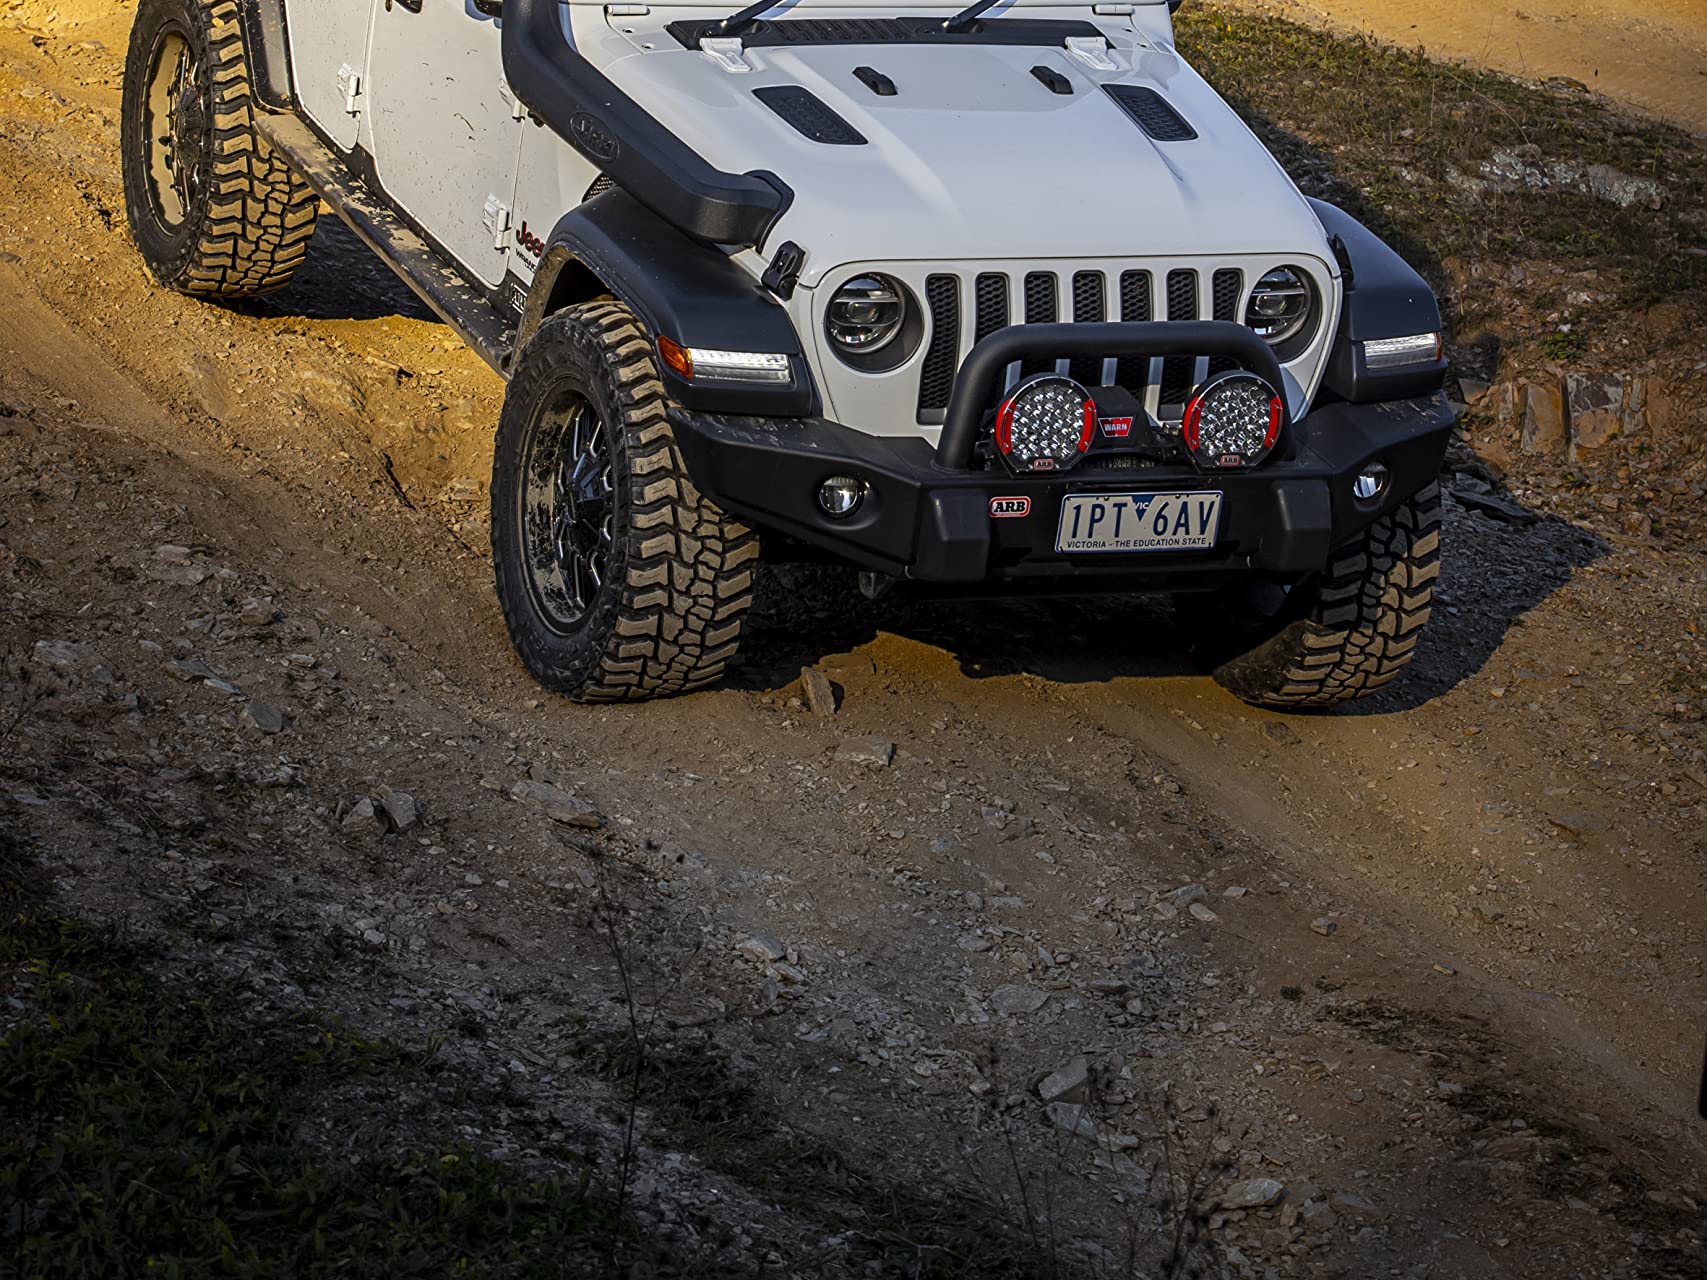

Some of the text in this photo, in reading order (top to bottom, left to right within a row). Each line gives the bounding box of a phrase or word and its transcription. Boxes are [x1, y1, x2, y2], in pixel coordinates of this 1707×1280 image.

[1104, 423, 1128, 431] WARN
[993, 501, 1026, 513] ARB
[1133, 502, 1150, 510] VIC
[1071, 501, 1215, 539] 1PT 6AV
[1067, 541, 1106, 549] VICTORIA
[1115, 540, 1131, 548] THE
[1133, 538, 1181, 547] EDUCATION
[1182, 537, 1207, 545] STATE
